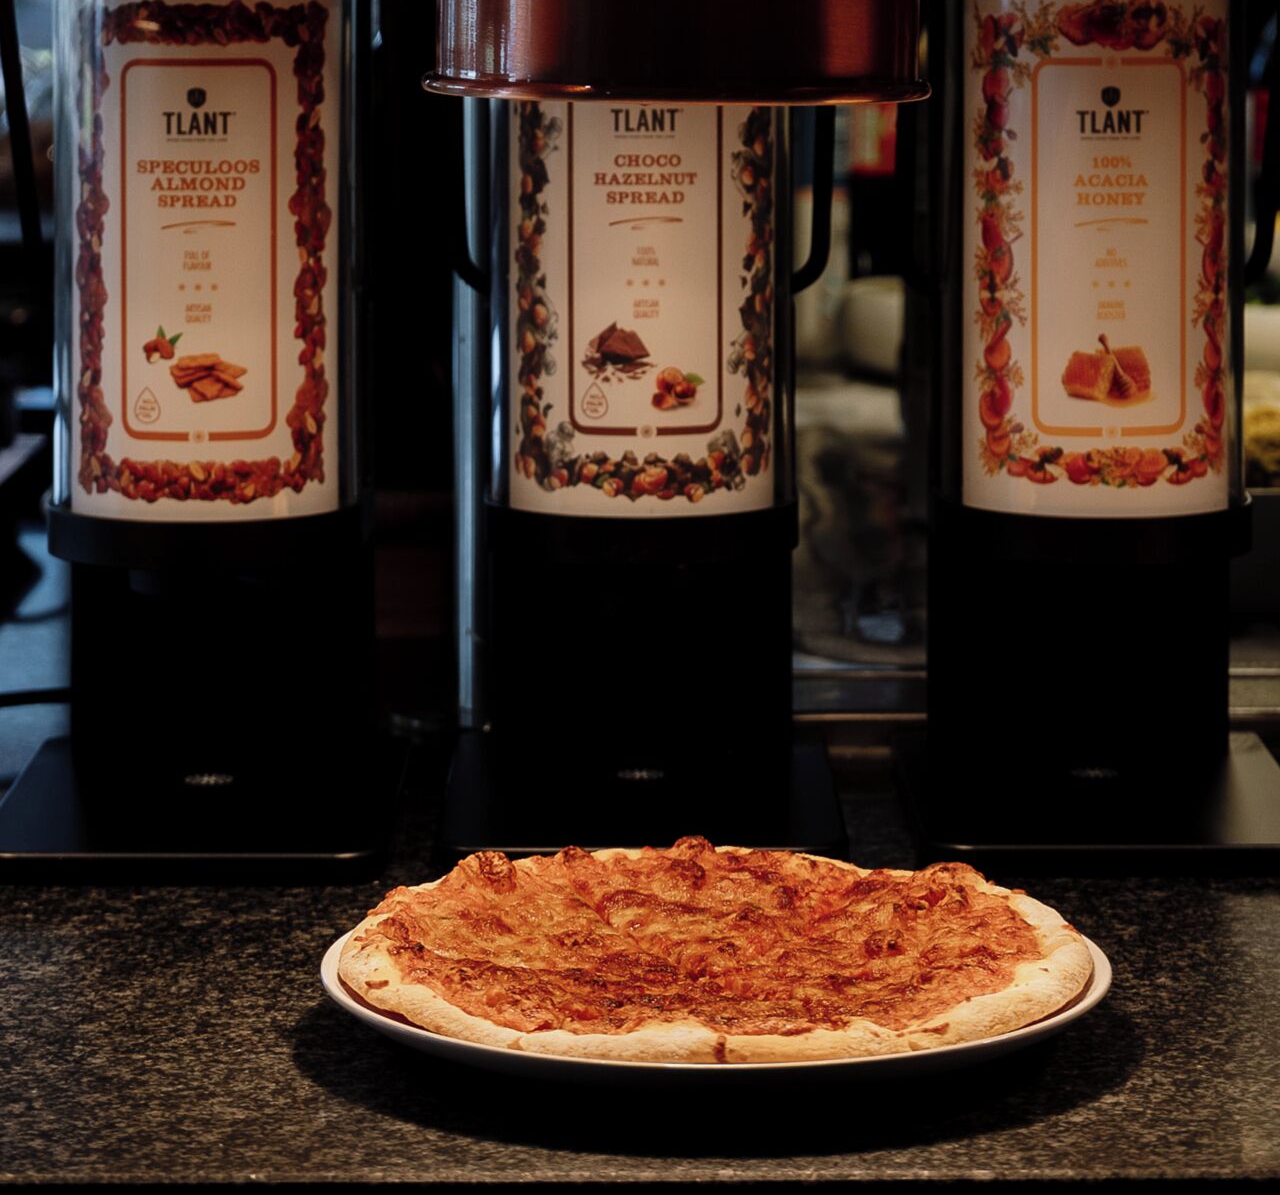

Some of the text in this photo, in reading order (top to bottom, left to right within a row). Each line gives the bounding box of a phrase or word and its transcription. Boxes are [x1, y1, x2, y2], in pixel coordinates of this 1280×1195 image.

[163, 111, 232, 136] TLANT
[611, 108, 680, 133] TLANT
[1076, 110, 1145, 134] TLANT
[136, 159, 261, 174] SPECULOOS
[614, 154, 682, 168] CHOCO
[1092, 156, 1132, 169] 100%
[151, 177, 246, 191] ALMOND
[594, 172, 697, 186] HAZELNUT
[1074, 173, 1149, 187] ACACIA
[157, 194, 237, 208] SPREAD
[606, 191, 684, 205] SPREAD
[1076, 192, 1146, 205] HONEY
